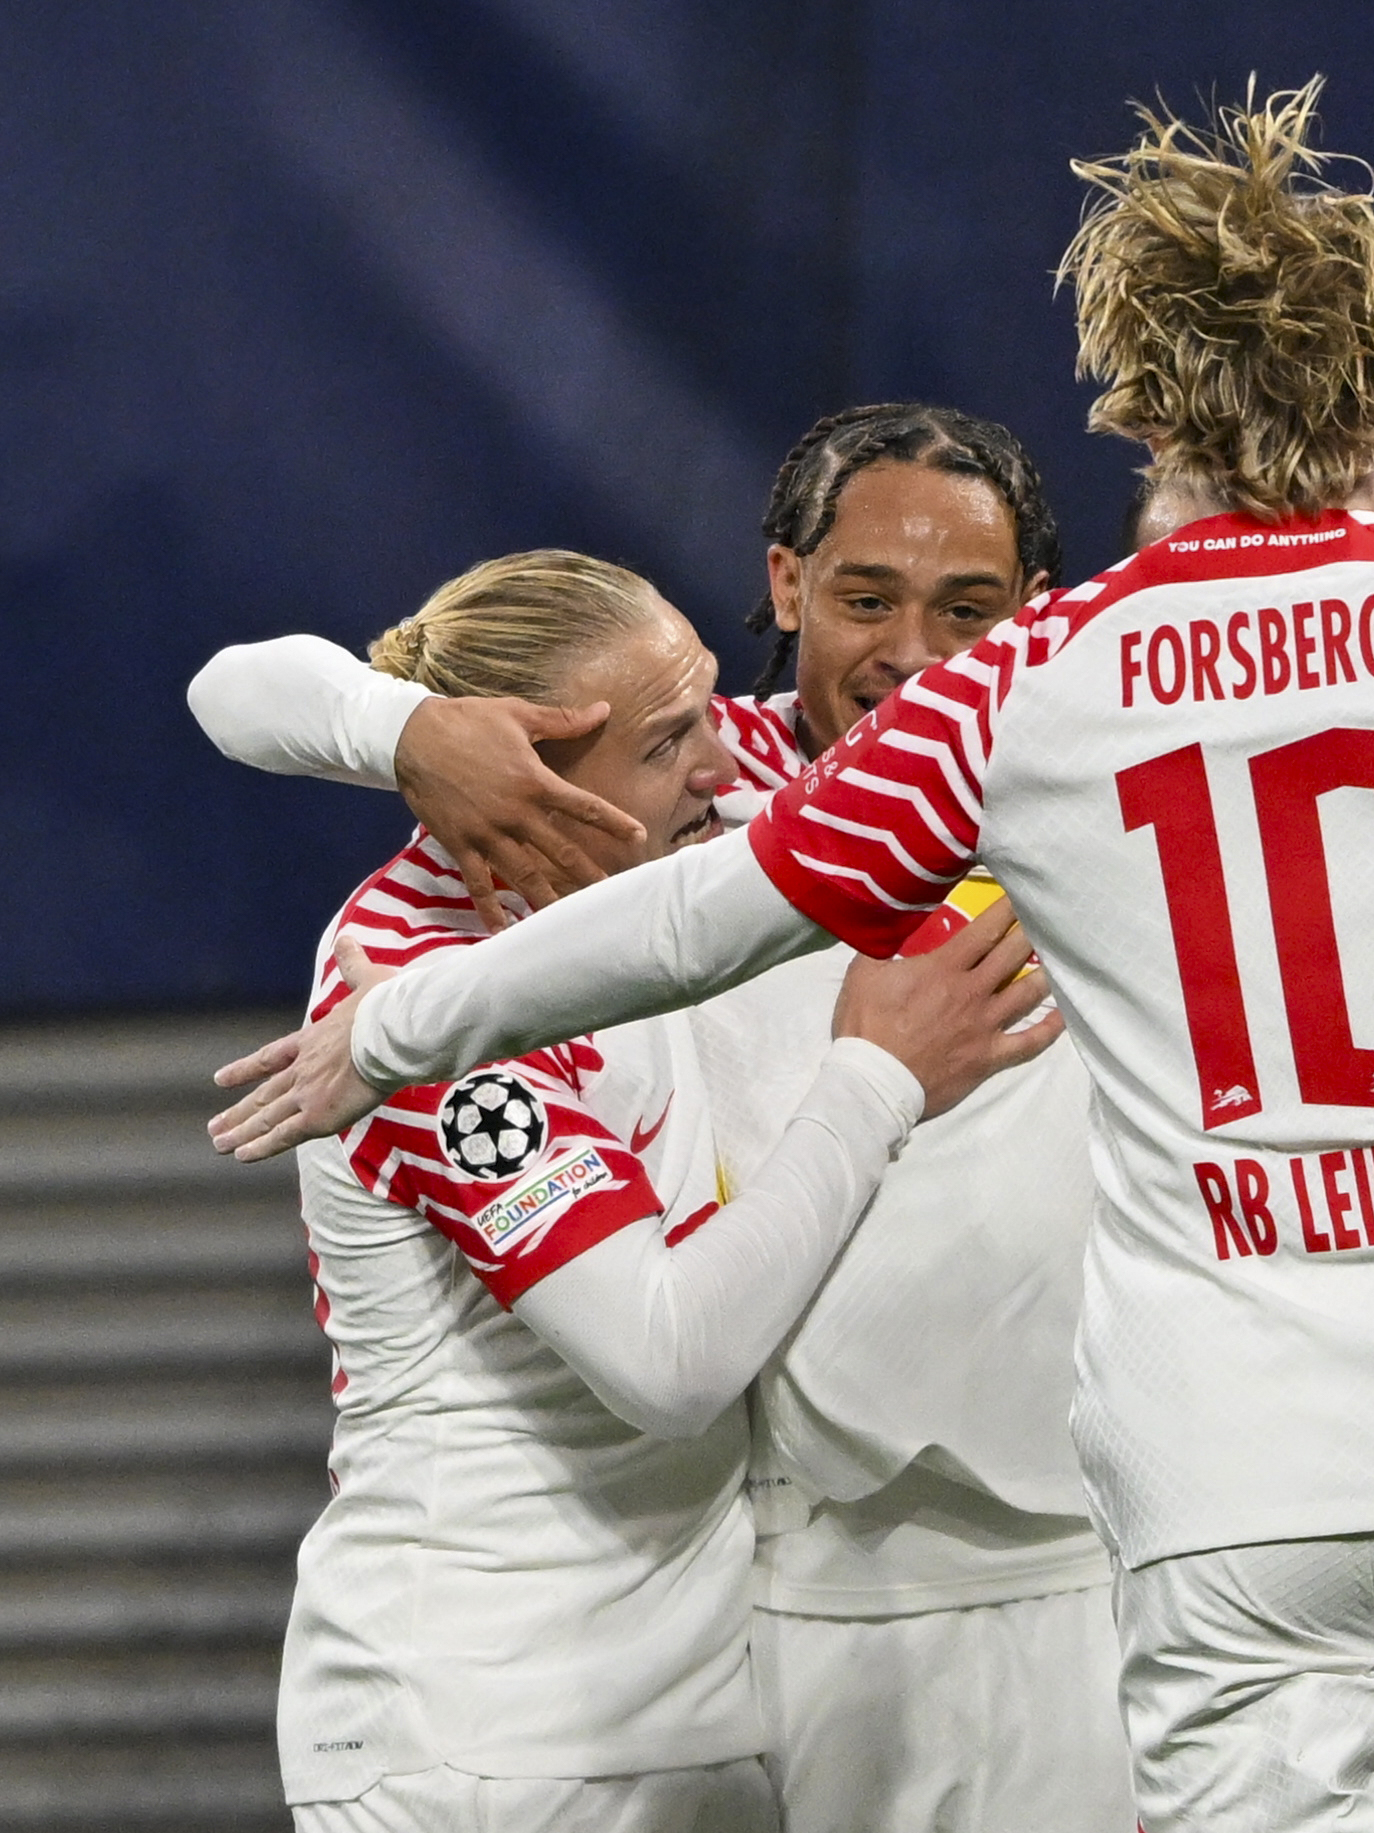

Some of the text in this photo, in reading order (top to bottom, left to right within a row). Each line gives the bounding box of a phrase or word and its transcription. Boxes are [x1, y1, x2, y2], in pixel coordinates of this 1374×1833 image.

[1168, 528, 1347, 552] YOU CAN DO ANYTHING
[476, 1203, 503, 1227] UEFA
[483, 1153, 601, 1241] FOUNDATION
[1192, 1156, 1279, 1261] RB
